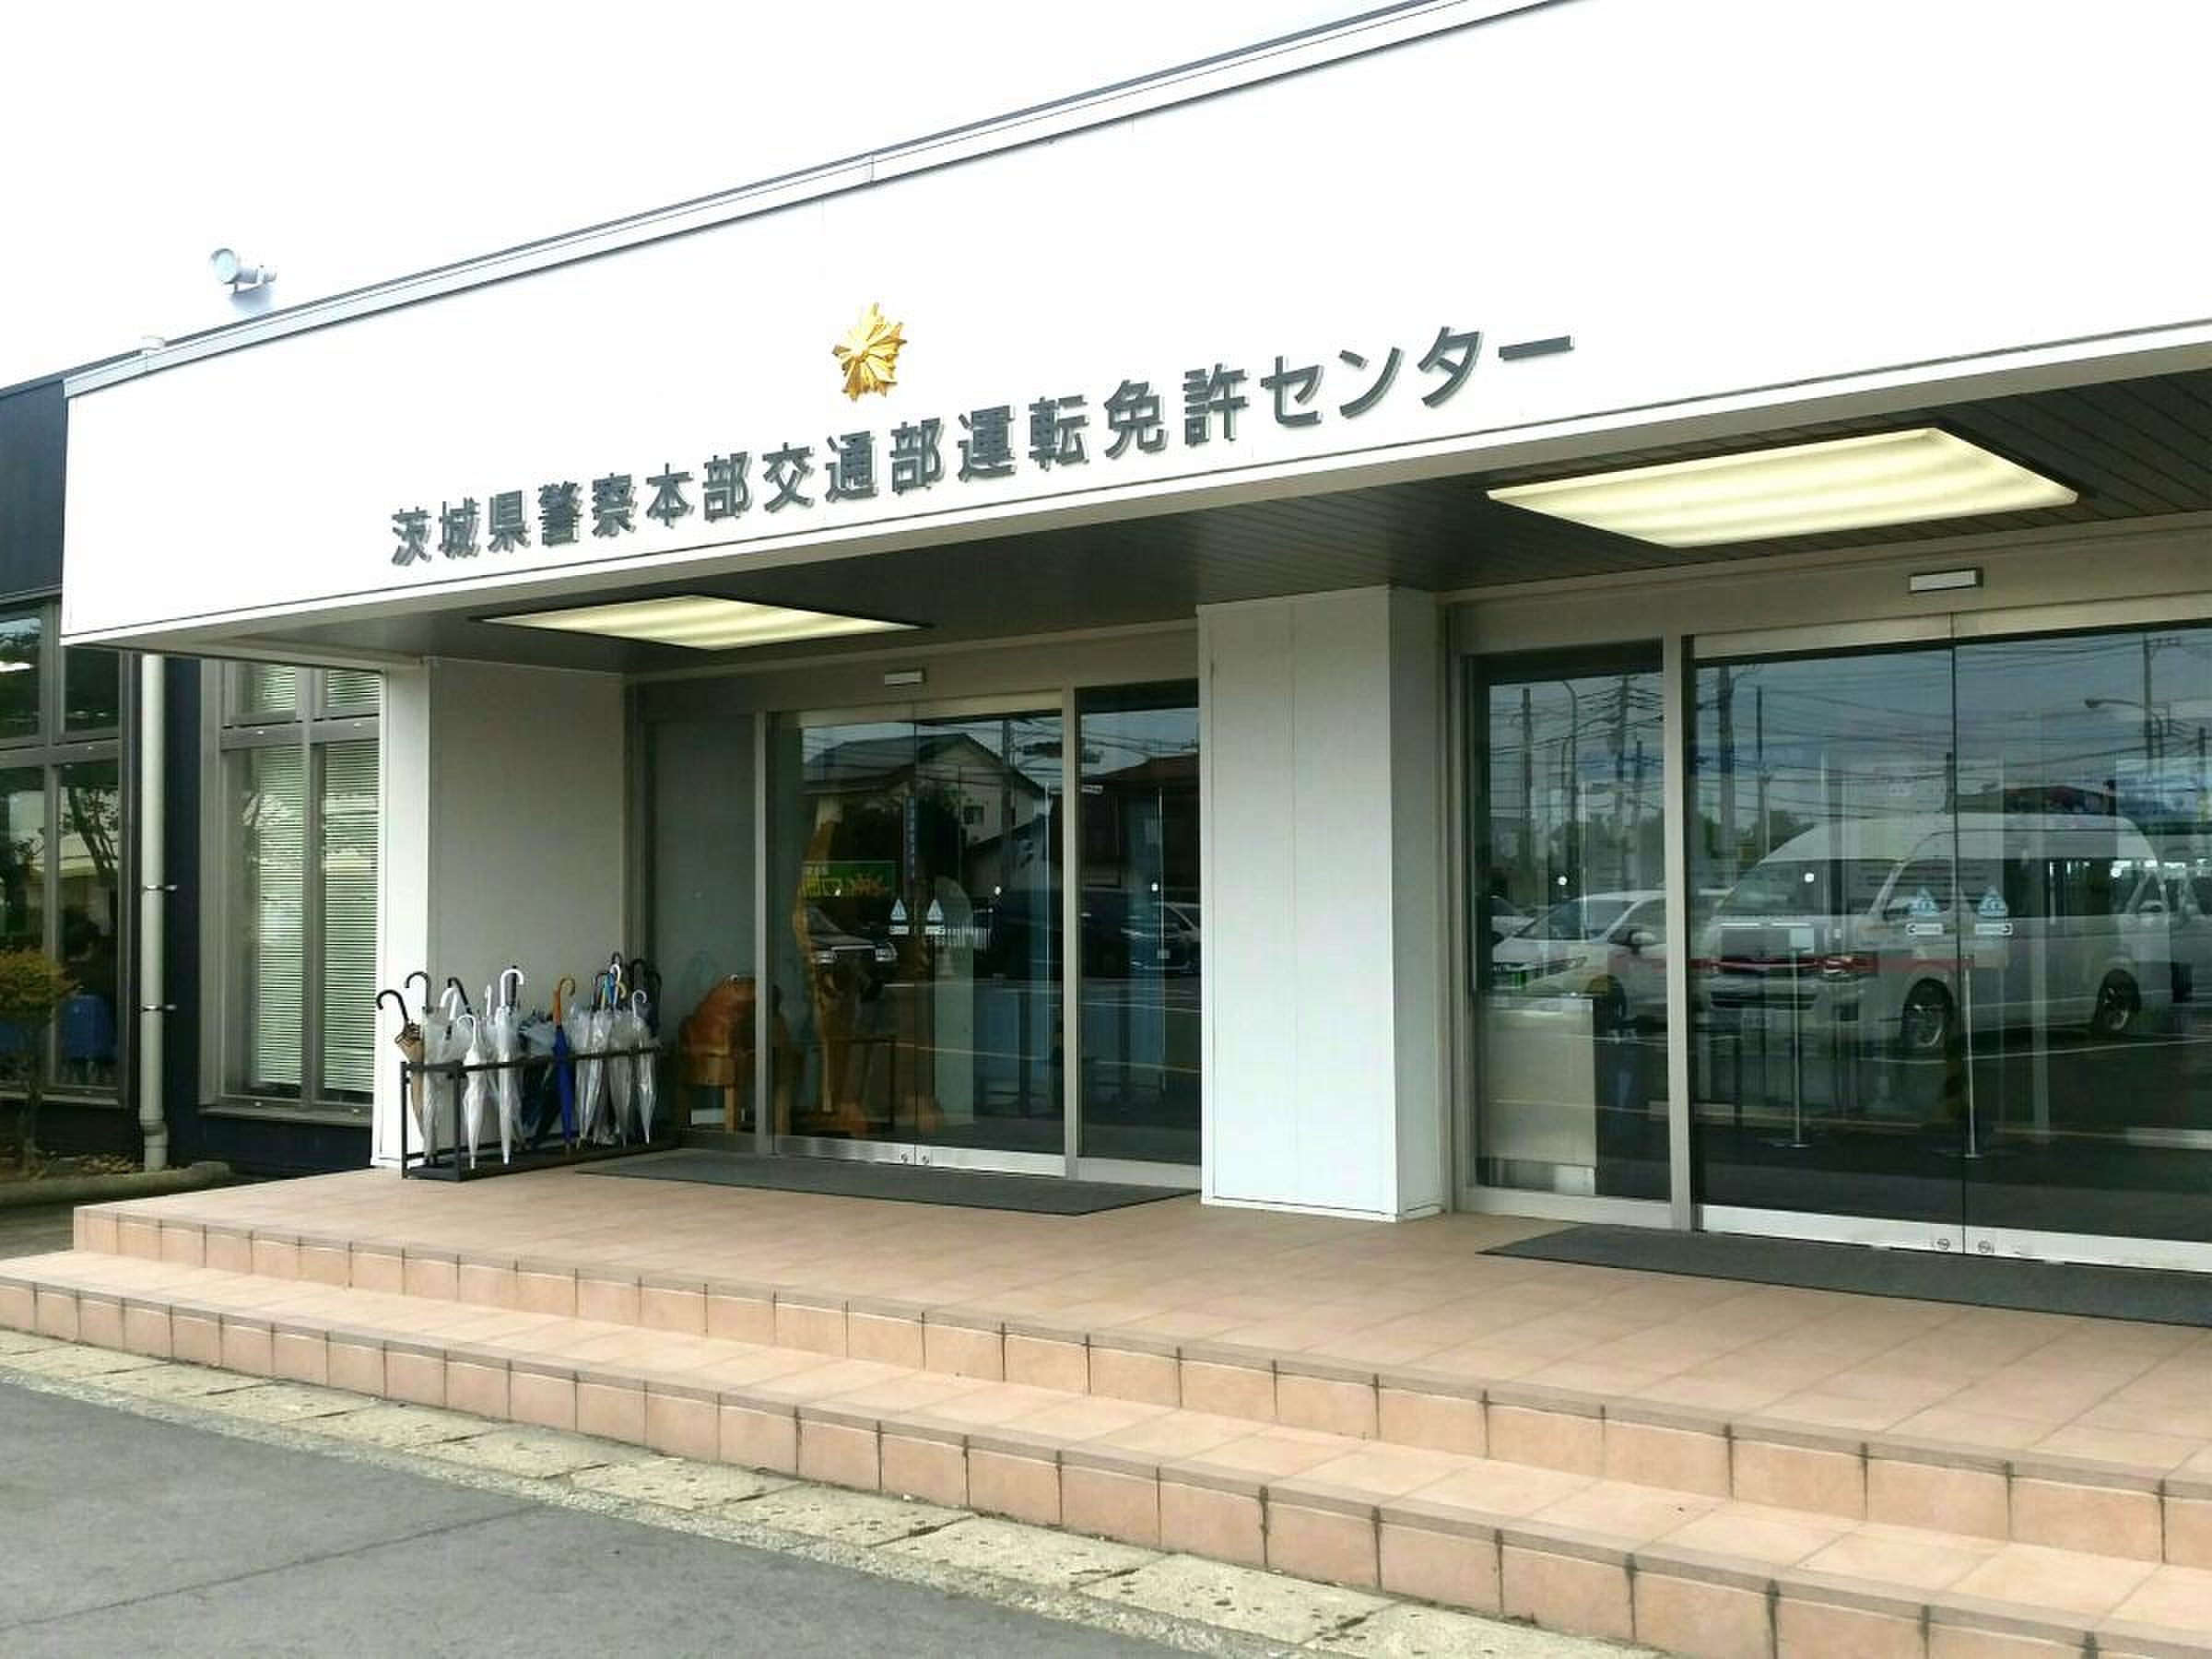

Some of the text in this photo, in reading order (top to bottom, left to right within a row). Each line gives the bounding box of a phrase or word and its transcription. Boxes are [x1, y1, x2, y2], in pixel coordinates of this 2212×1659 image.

[392, 325, 1575, 567] 茨城県警察本部交通部運転免許センター
